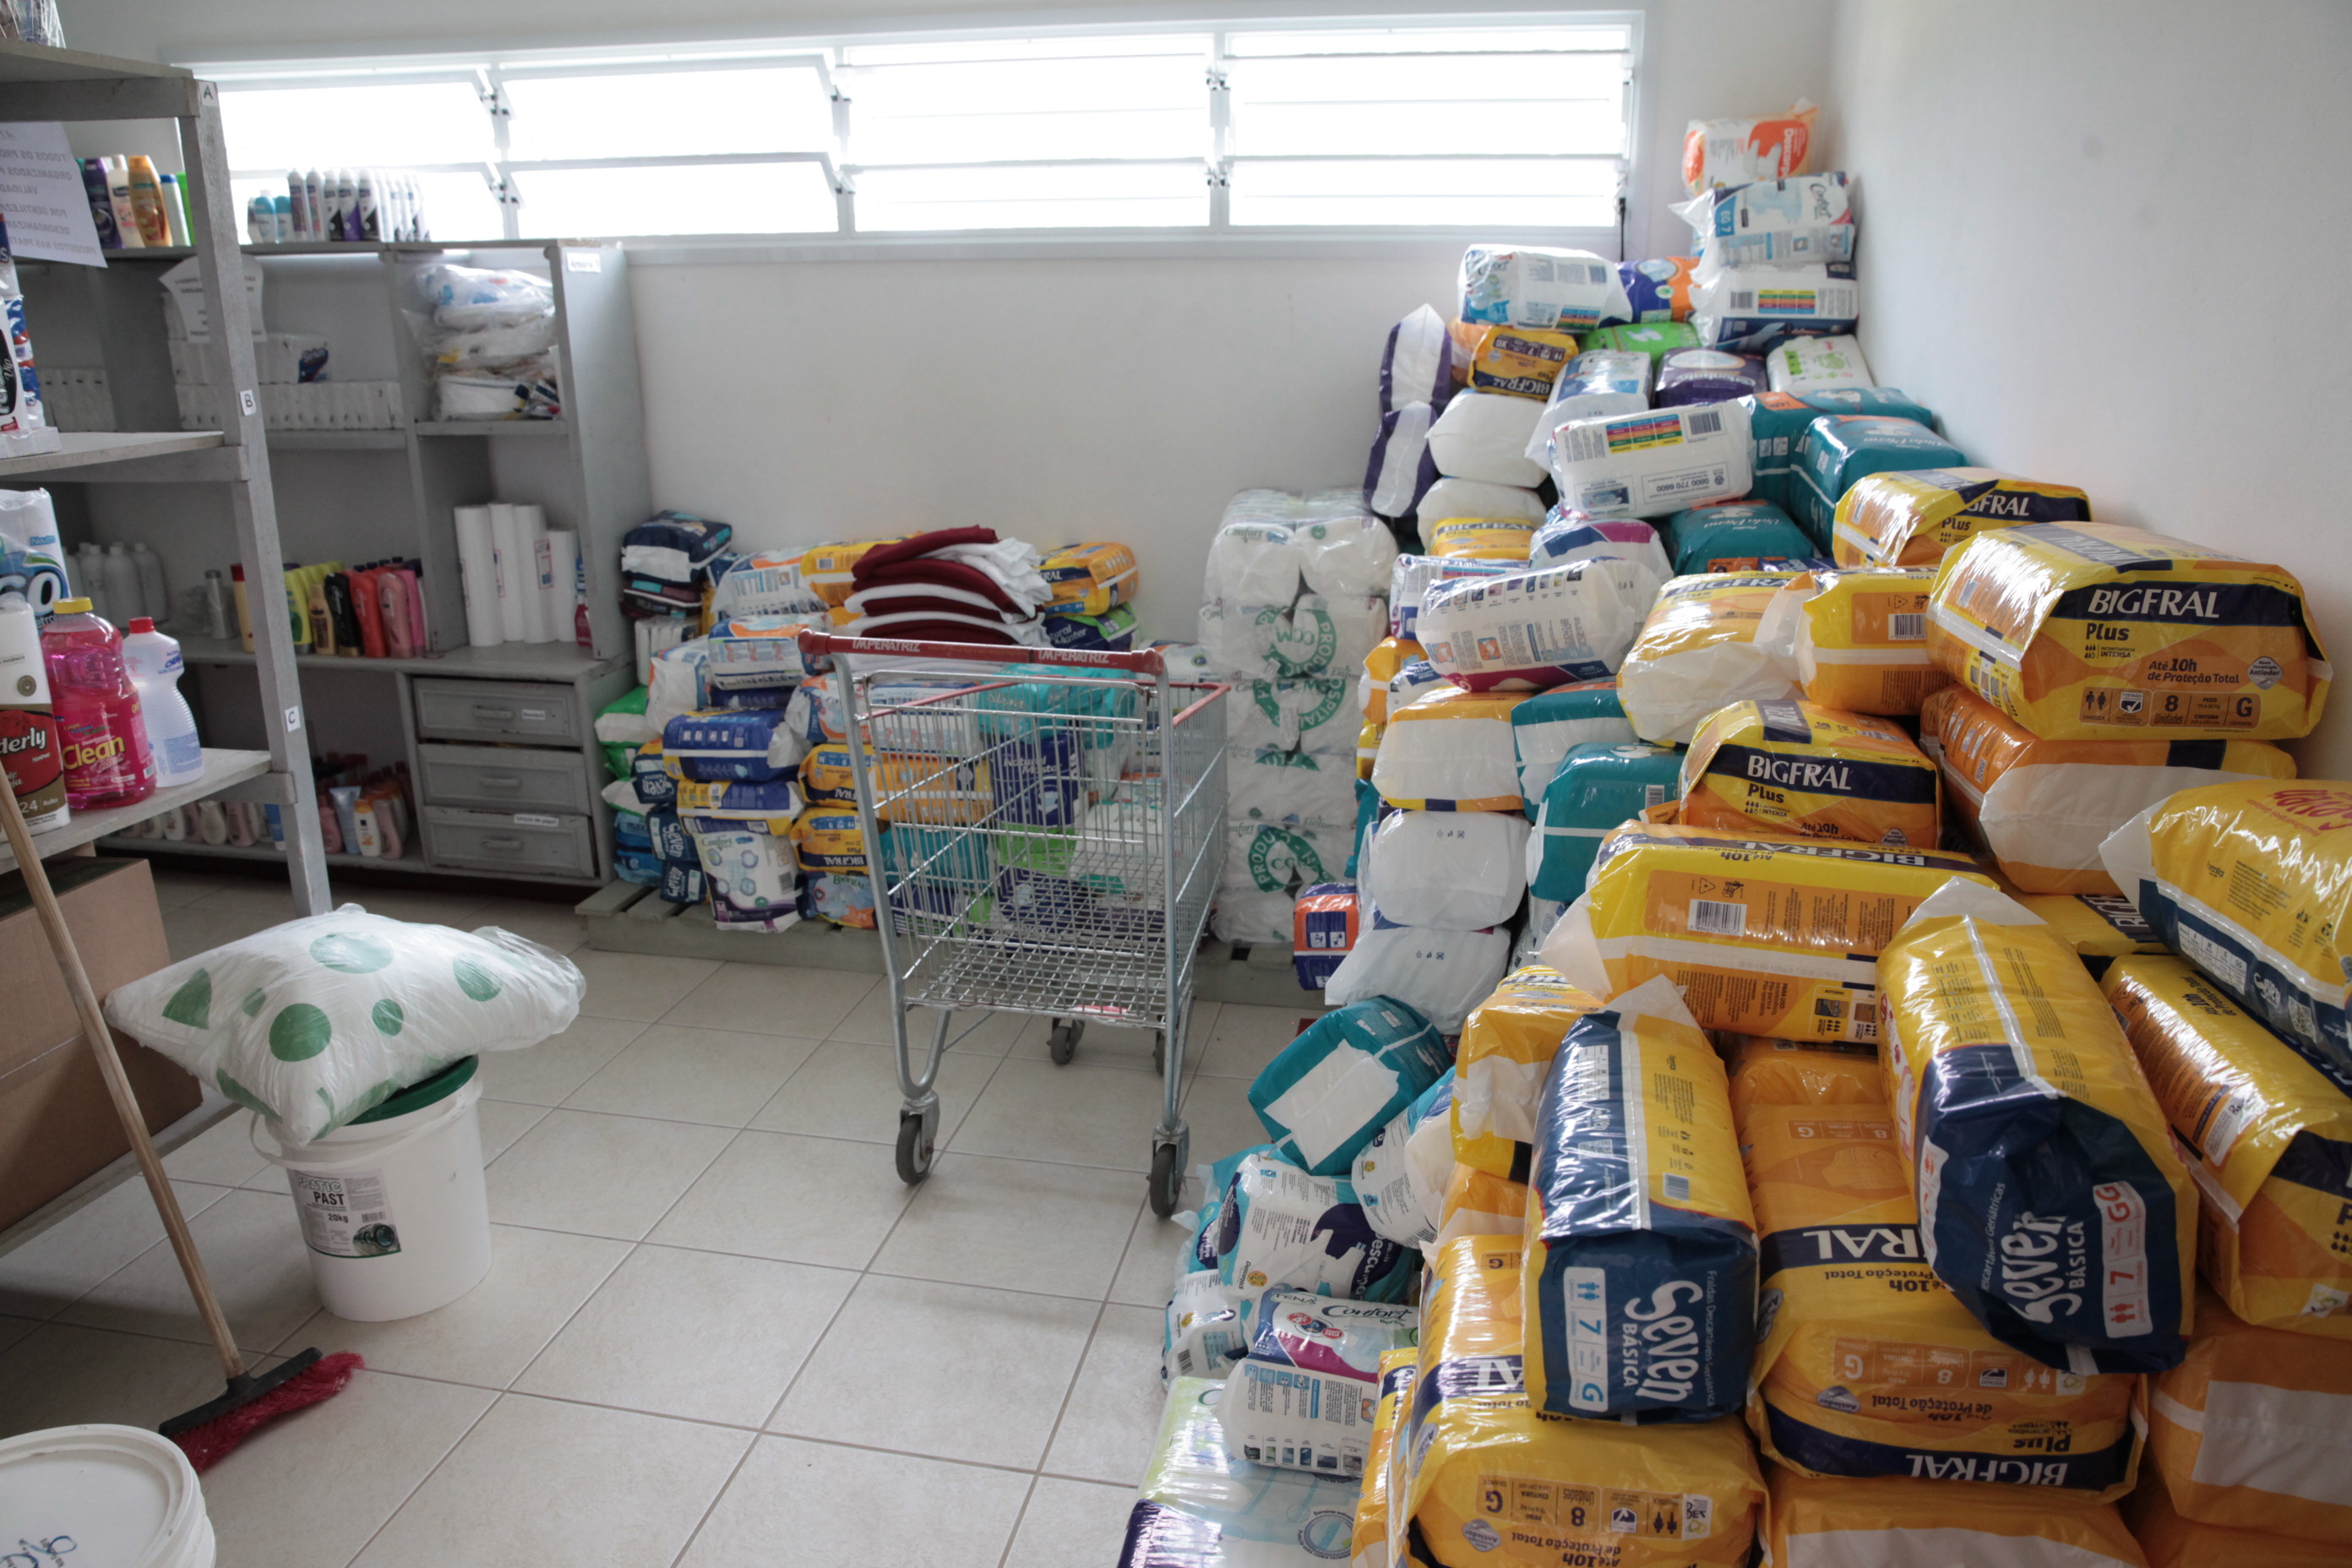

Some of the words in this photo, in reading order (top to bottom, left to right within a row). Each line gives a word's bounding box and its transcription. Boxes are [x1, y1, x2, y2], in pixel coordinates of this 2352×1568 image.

[204, 85, 214, 100] A
[244, 394, 253, 407] B
[1941, 517, 1970, 531] Plus
[2088, 589, 2220, 618] BIGFRAL
[2086, 623, 2130, 641] Plus
[852, 639, 921, 653] IMPERATRIZ
[1038, 650, 1109, 664] IMPERATRIZ
[2148, 659, 2169, 672] Até
[2169, 658, 2197, 672] 10h
[2148, 672, 2161, 681] de
[2163, 672, 2212, 686] Proteção
[2213, 673, 2240, 684] Total
[2249, 668, 2280, 677] Antiodor
[2164, 694, 2179, 712] 8
[2236, 696, 2252, 717] G
[287, 710, 297, 724] C
[62, 736, 125, 770] Clean
[1747, 754, 1853, 791] BIGFRAL
[1747, 782, 1785, 803] Plus
[1799, 822, 1817, 832] Até
[824, 854, 865, 866] BIGFRAL
[1720, 852, 1750, 862] 10h
[1737, 841, 1925, 867] BIGFRAL
[1797, 1127, 1815, 1138] G
[313, 1191, 345, 1206] PAST
[2094, 1185, 2132, 1223] GG
[328, 1212, 349, 1223] 20kg
[1802, 1228, 1919, 1260] RAL
[2066, 1222, 2087, 1289] BÁSICA
[1825, 1269, 1865, 1280] Total
[1865, 1270, 1935, 1279] Proteção
[2109, 1270, 2135, 1286] 7
[1706, 1271, 1718, 1304] Fraldas
[1889, 1279, 1930, 1292] 10h
[1274, 1293, 1317, 1305] TENA
[1321, 1304, 1413, 1321] Confort
[1578, 1320, 1602, 1336] 7
[1624, 1280, 1704, 1402] Seven
[1622, 1323, 1643, 1387] BÁSICA
[1843, 1355, 1864, 1380] G
[1937, 1369, 1954, 1385] 8
[1582, 1382, 1603, 1402] G
[1871, 1395, 1907, 1410] Total
[1909, 1397, 1974, 1413] Proteção
[1975, 1402, 1993, 1414] de
[2012, 1436, 2072, 1452] Plus
[1904, 1454, 2068, 1487] BIGFRAL
[1484, 1490, 1503, 1513] G
[1571, 1505, 1585, 1527] 8
[1511, 1532, 1544, 1544] Total
[1544, 1536, 1603, 1556] Proteção
[1605, 1543, 1622, 1555] de
[1561, 1551, 1595, 1568] 10h
